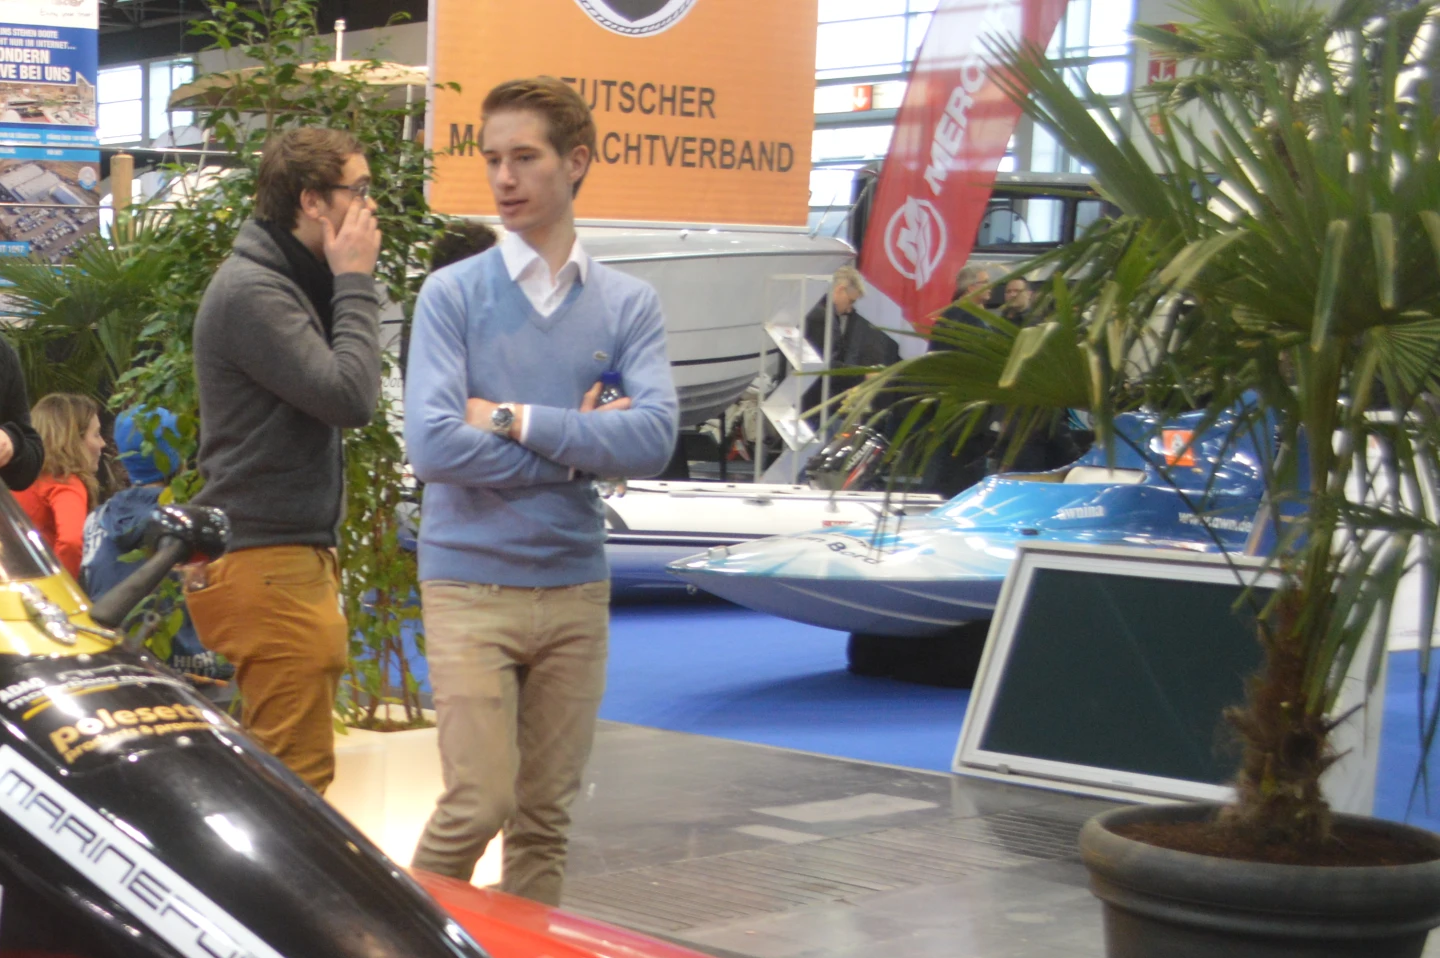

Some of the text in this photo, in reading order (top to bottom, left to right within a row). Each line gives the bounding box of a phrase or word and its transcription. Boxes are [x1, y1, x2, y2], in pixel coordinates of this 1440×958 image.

[19, 65, 42, 81] BEI
[44, 66, 71, 82] UNS
[561, 77, 716, 120] UTSCHER
